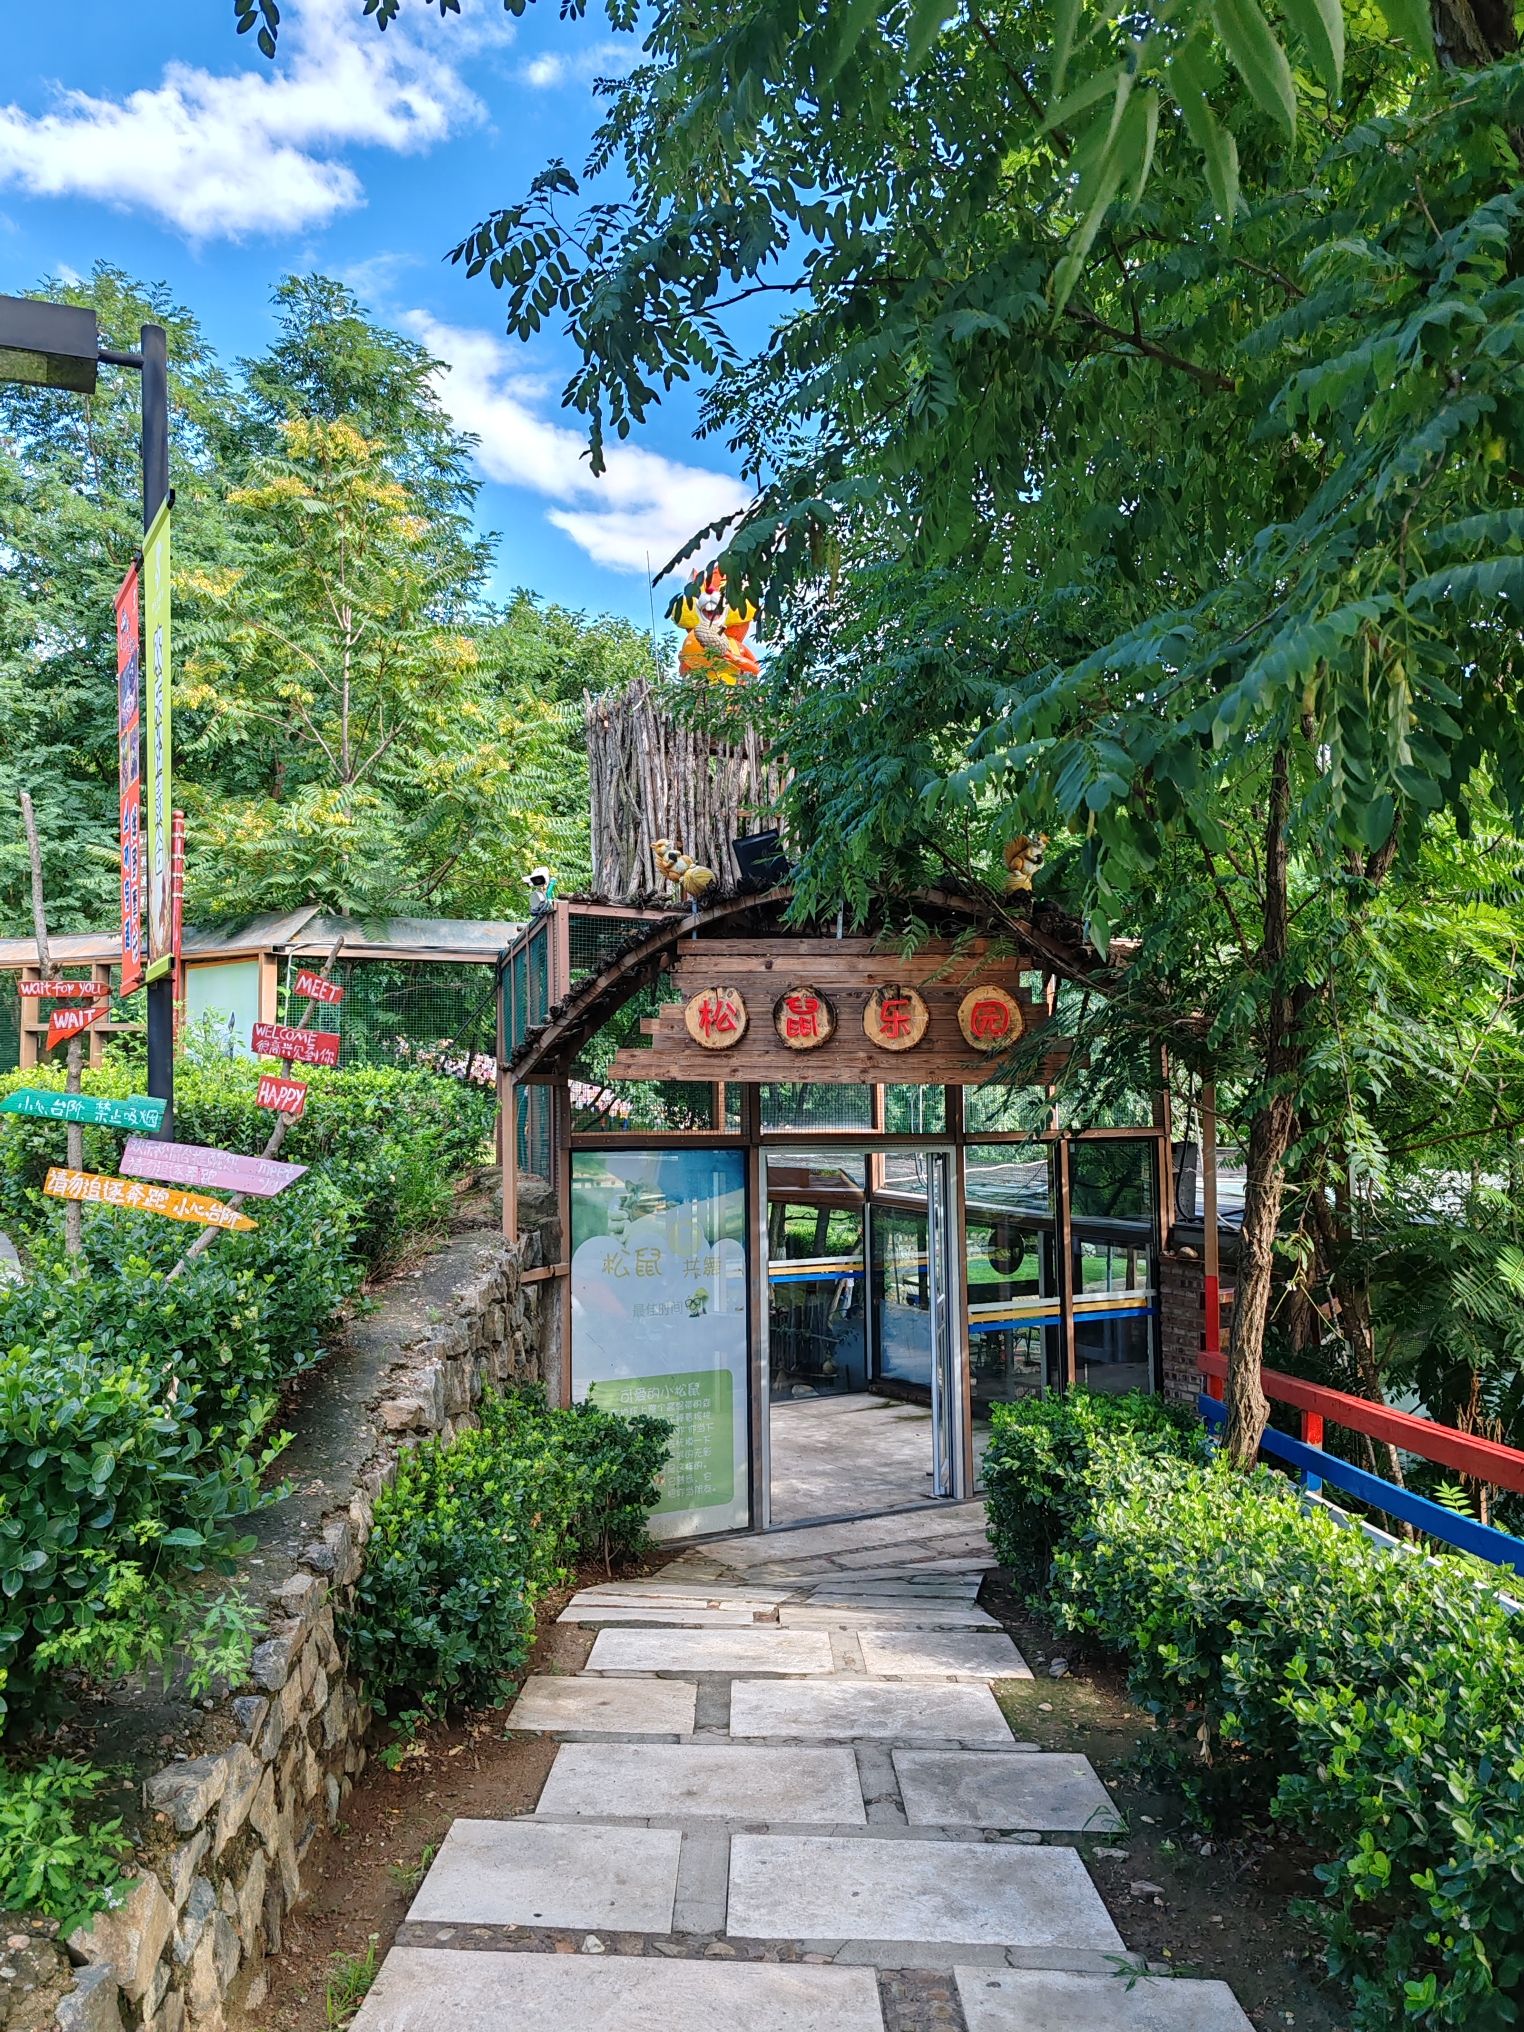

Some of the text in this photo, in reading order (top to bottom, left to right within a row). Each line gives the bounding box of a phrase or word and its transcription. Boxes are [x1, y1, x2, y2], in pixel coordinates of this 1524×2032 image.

[21, 981, 50, 995] wait
[80, 982, 101, 994] you
[296, 975, 339, 1001] MEET
[54, 1009, 96, 1029] WAIT
[699, 996, 1011, 1039] 松鼠乐园
[255, 1024, 318, 1047] WELCOME
[256, 1040, 335, 1065] 很高兴见到你
[258, 1081, 306, 1113] HAPPY
[47, 1170, 243, 1229] 请勿追逐奔跑 小心台阶
[602, 1247, 662, 1279] 松鼠
[620, 1382, 700, 1404] 可爱的小松鼠
